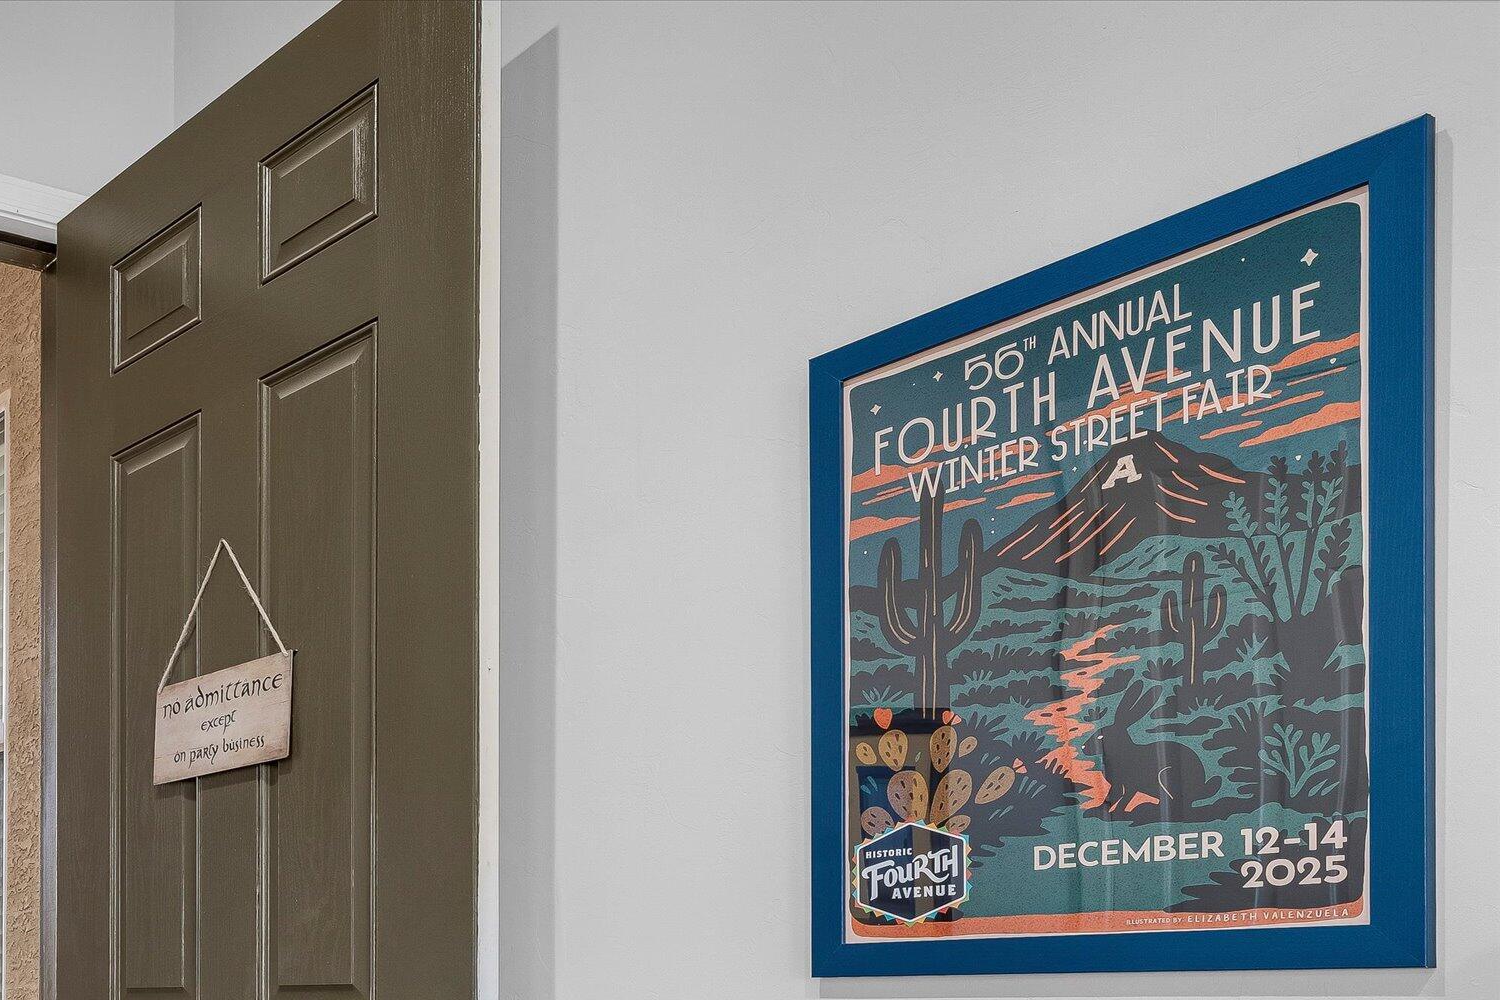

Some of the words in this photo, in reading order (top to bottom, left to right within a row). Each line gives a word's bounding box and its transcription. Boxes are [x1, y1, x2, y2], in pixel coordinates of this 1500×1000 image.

[1047, 283, 1193, 366] ANNUAL
[873, 371, 1057, 476] FOURTH
[1086, 280, 1322, 410] AVENUE
[908, 435, 1039, 503] WINTER
[1051, 391, 1169, 462] STREET
[1182, 364, 1273, 425] FAIR
[1101, 454, 1144, 490] A
[184, 673, 283, 714] admittance
[200, 710, 237, 735] except
[173, 751, 186, 763] on
[188, 743, 219, 769] party
[222, 735, 265, 753] business
[865, 847, 913, 859] HISTORIC
[1032, 831, 1225, 872] DECEMBER
[1240, 819, 1348, 856] 12-14
[1240, 854, 1349, 889] 2025
[891, 884, 957, 900] AVENUE
[1126, 916, 1171, 925] ILLUSTRATED
[1187, 911, 1258, 923] ELIZABETH
[1263, 908, 1349, 920] VALENZUELA
